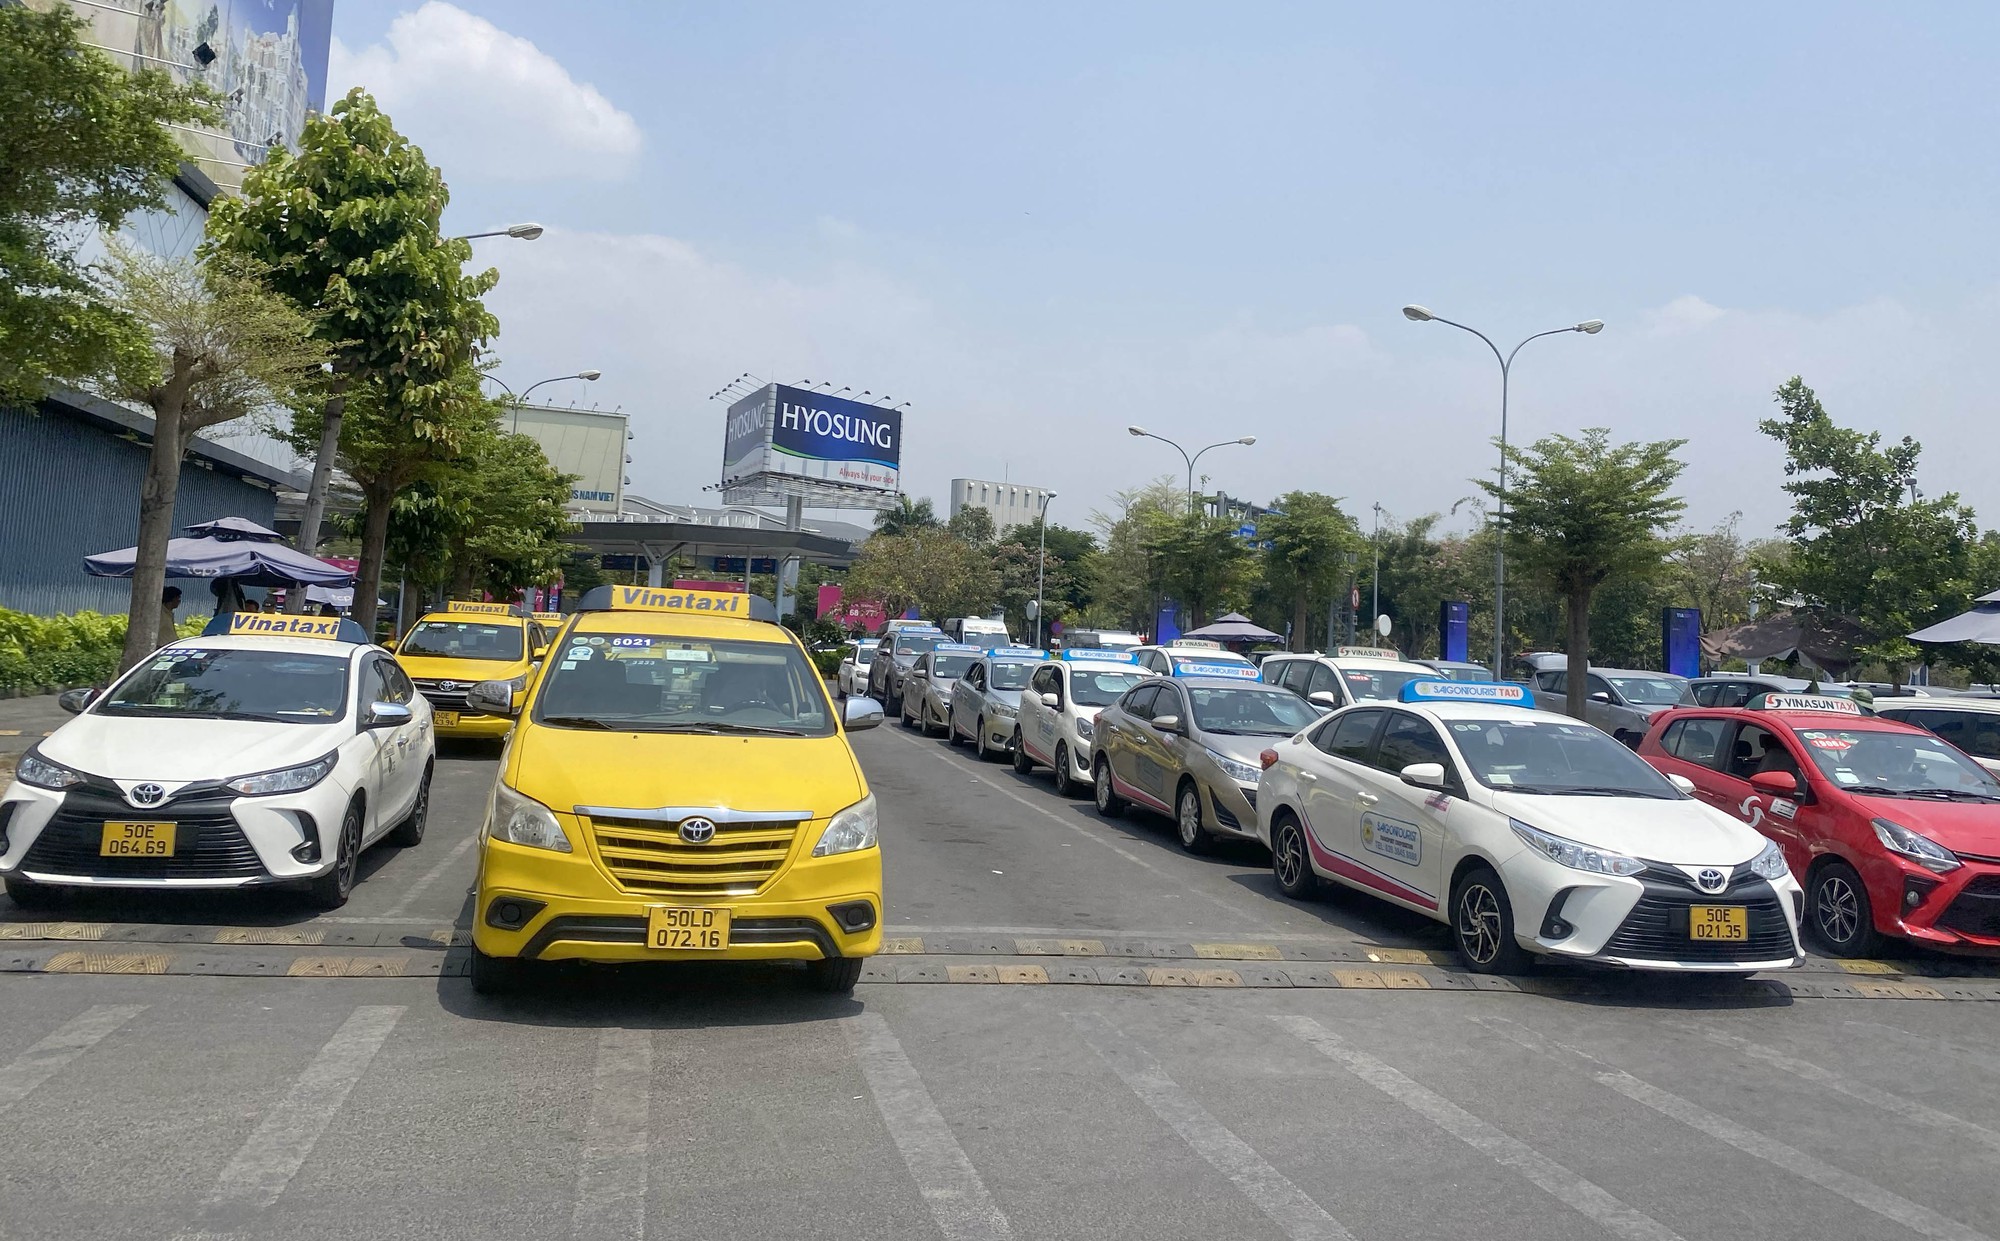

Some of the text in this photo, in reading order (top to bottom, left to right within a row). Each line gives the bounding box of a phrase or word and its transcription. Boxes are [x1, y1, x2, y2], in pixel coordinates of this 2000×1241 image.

[728, 403, 766, 443] HYOSUNG
[781, 402, 892, 449] HYOSUNG
[839, 467, 860, 479] Always
[861, 472, 869, 481] by
[869, 474, 883, 482] your
[580, 490, 597, 501] NAM
[624, 588, 739, 612] Vinataxi
[453, 603, 505, 613] Vinataxi
[233, 613, 340, 636] Vinataxi
[612, 637, 651, 646] 6021
[1193, 665, 1240, 675] SAIGONTOURIST
[1433, 685, 1519, 697] SAIGONTOURIST TAXI
[124, 824, 155, 838] 50E
[1377, 821, 1417, 842] SAIGONTOURIST
[109, 840, 166, 854] 064.69
[667, 910, 713, 927] 50LD
[1706, 908, 1731, 922] 50E
[1697, 924, 1741, 938] 021.35
[657, 930, 720, 947] 072.16
